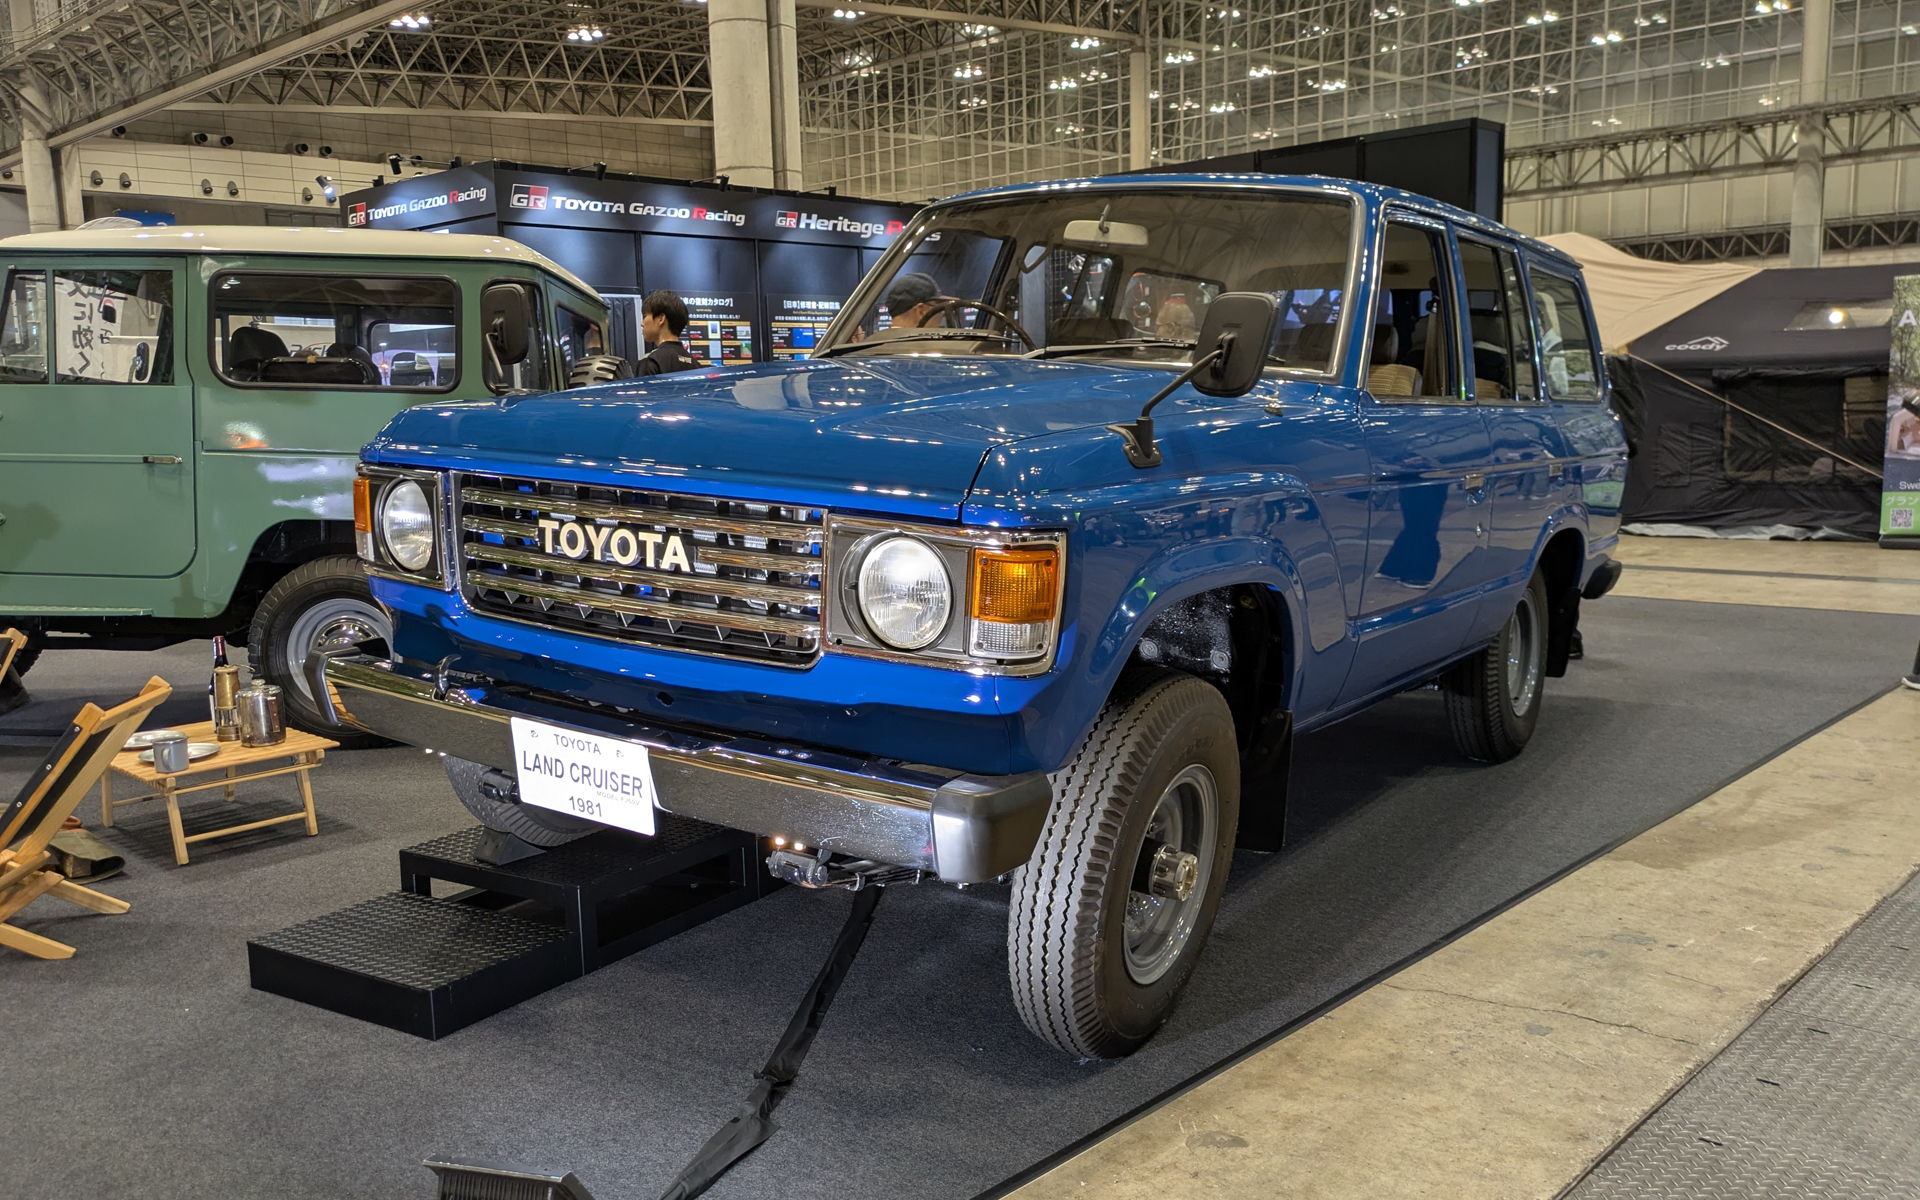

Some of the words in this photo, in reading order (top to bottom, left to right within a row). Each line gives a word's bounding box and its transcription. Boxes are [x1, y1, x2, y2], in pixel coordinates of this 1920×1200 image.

[367, 203, 408, 220] TOYOTA
[409, 194, 448, 212] GAZOO
[449, 186, 487, 204] Racing
[551, 196, 625, 213] TOYOTA
[629, 202, 690, 219] GAZOO
[692, 207, 746, 226] Racing
[799, 212, 885, 238] Heritage
[1665, 343, 1727, 351] coody
[538, 519, 691, 572] TOYOTA
[553, 733, 602, 755] TOYOTA
[523, 750, 564, 779] LAND
[569, 762, 643, 798] CRUISER
[569, 795, 603, 817] 1981
